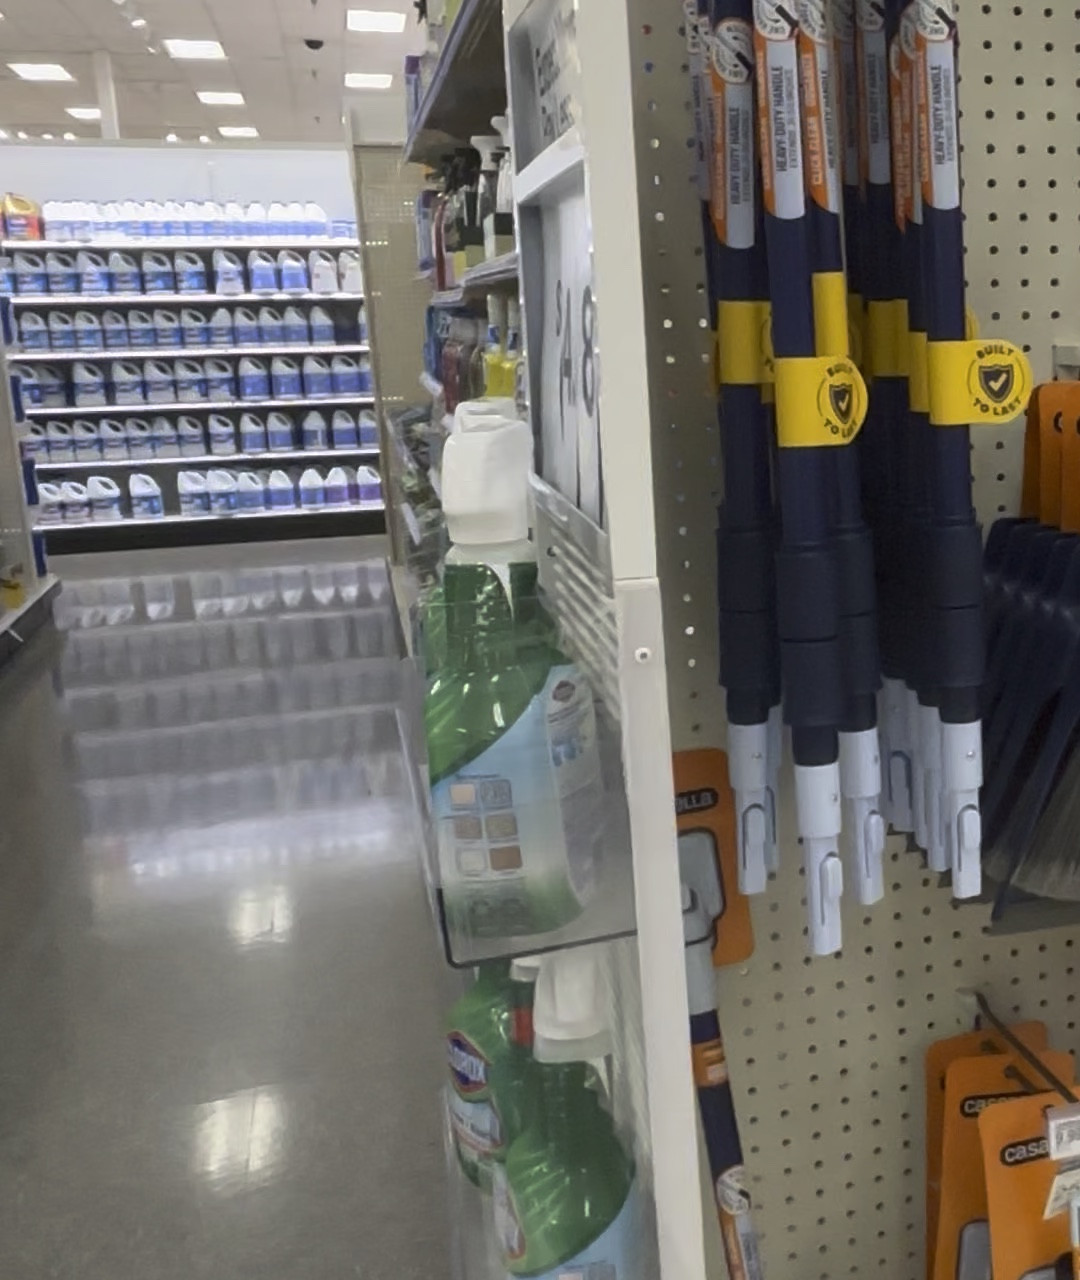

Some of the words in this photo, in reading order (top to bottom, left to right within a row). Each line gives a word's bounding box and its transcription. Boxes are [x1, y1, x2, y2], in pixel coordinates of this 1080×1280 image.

[975, 343, 1015, 360] BUILT
[972, 396, 990, 415] TO
[993, 396, 1023, 417] LAST
